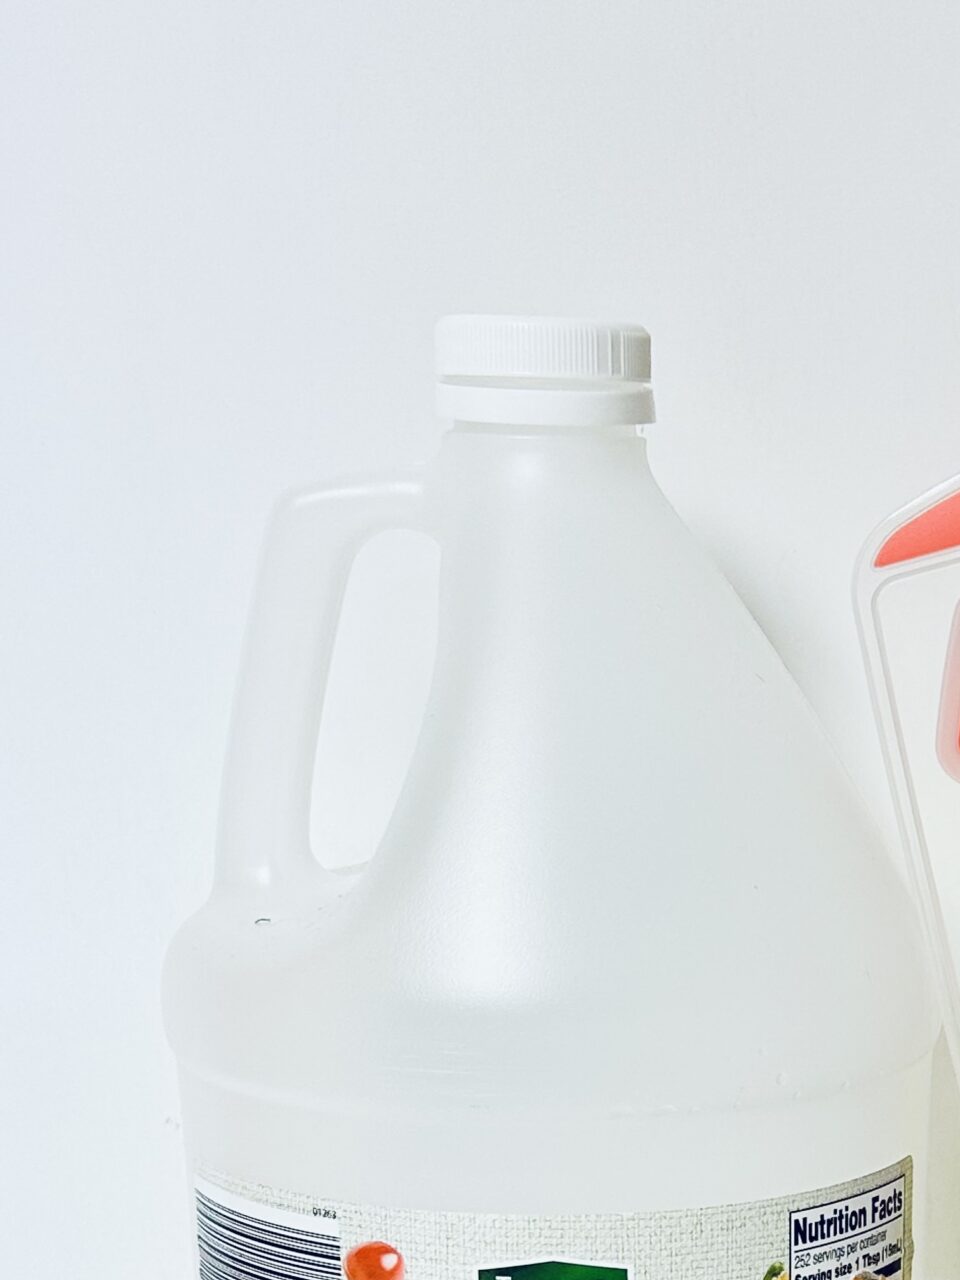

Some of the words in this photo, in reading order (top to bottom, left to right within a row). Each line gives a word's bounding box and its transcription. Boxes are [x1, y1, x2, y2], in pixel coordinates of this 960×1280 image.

[793, 1205, 868, 1247] Nutrition
[871, 1188, 903, 1224] Facts
[794, 1253, 811, 1270] 252
[812, 1244, 846, 1266] servings
[846, 1241, 858, 1258] per
[859, 1229, 889, 1251] container
[835, 1263, 853, 1278] size
[855, 1258, 860, 1271] 1
[862, 1251, 881, 1268] Tbsp
